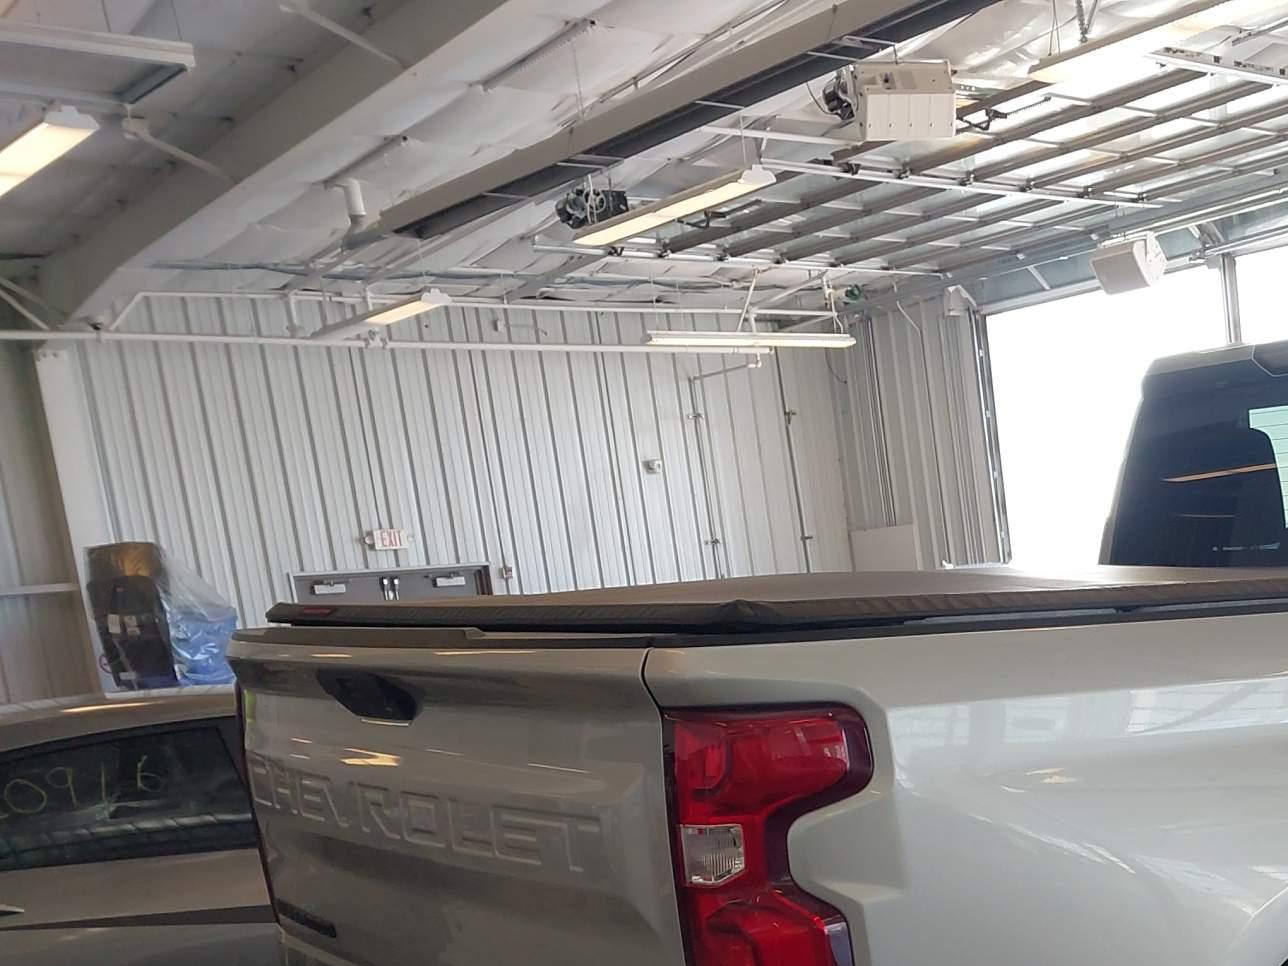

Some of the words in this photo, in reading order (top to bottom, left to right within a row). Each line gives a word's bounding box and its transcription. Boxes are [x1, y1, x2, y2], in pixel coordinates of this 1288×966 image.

[380, 529, 402, 547] EXIT
[0, 755, 164, 820] 0916
[247, 750, 602, 873] CHEVROLET
